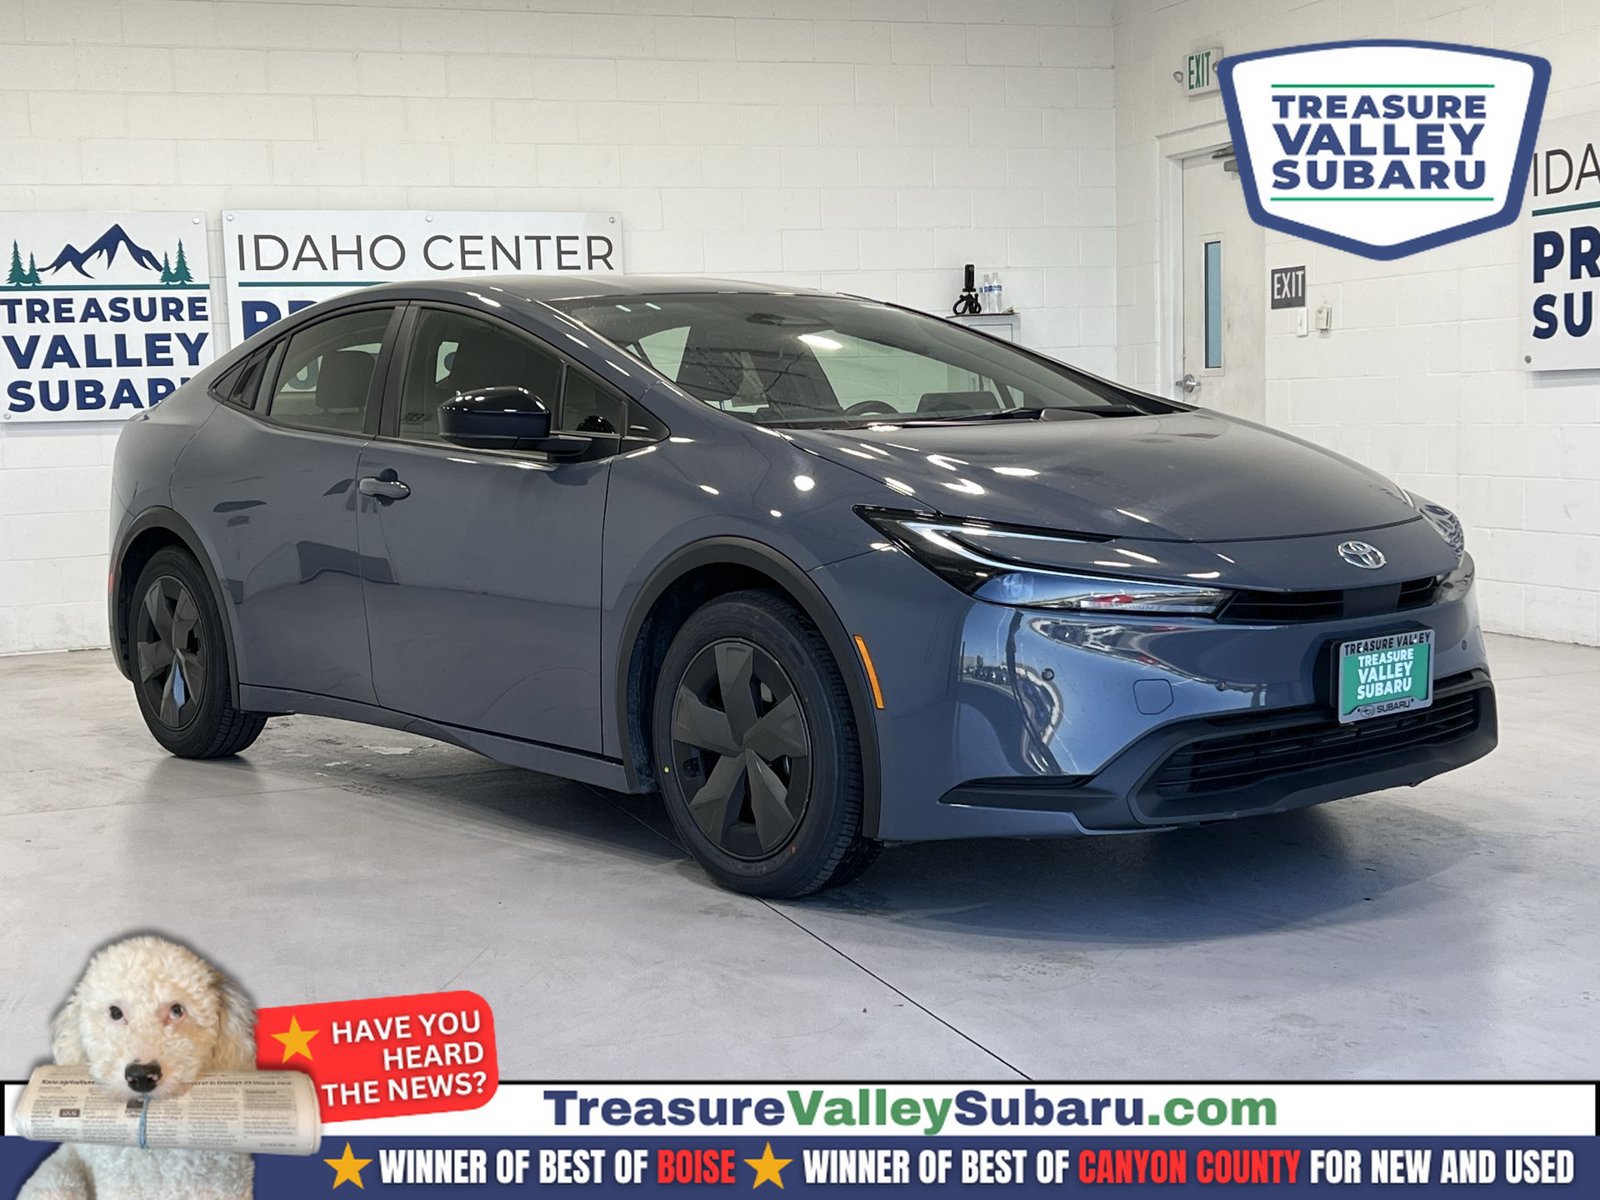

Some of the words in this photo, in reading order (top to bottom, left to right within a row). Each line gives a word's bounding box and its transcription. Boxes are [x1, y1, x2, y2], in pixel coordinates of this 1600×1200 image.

[1188, 51, 1211, 90] EXIT
[237, 234, 406, 271] IDAHO
[423, 234, 614, 271] CENTER
[1533, 225, 1600, 284] PR
[1273, 270, 1305, 300] EXIT
[0, 296, 209, 324] TREASURE
[1532, 290, 1593, 340] SU
[1, 332, 209, 370] VALLEY
[6, 377, 191, 413] SUBAR
[1344, 637, 1394, 656] TREASURE
[1358, 648, 1414, 668] TREASURE
[1358, 661, 1414, 684] VALLEY
[1357, 677, 1412, 700] SUBARU
[1376, 700, 1411, 714] SUBARU
